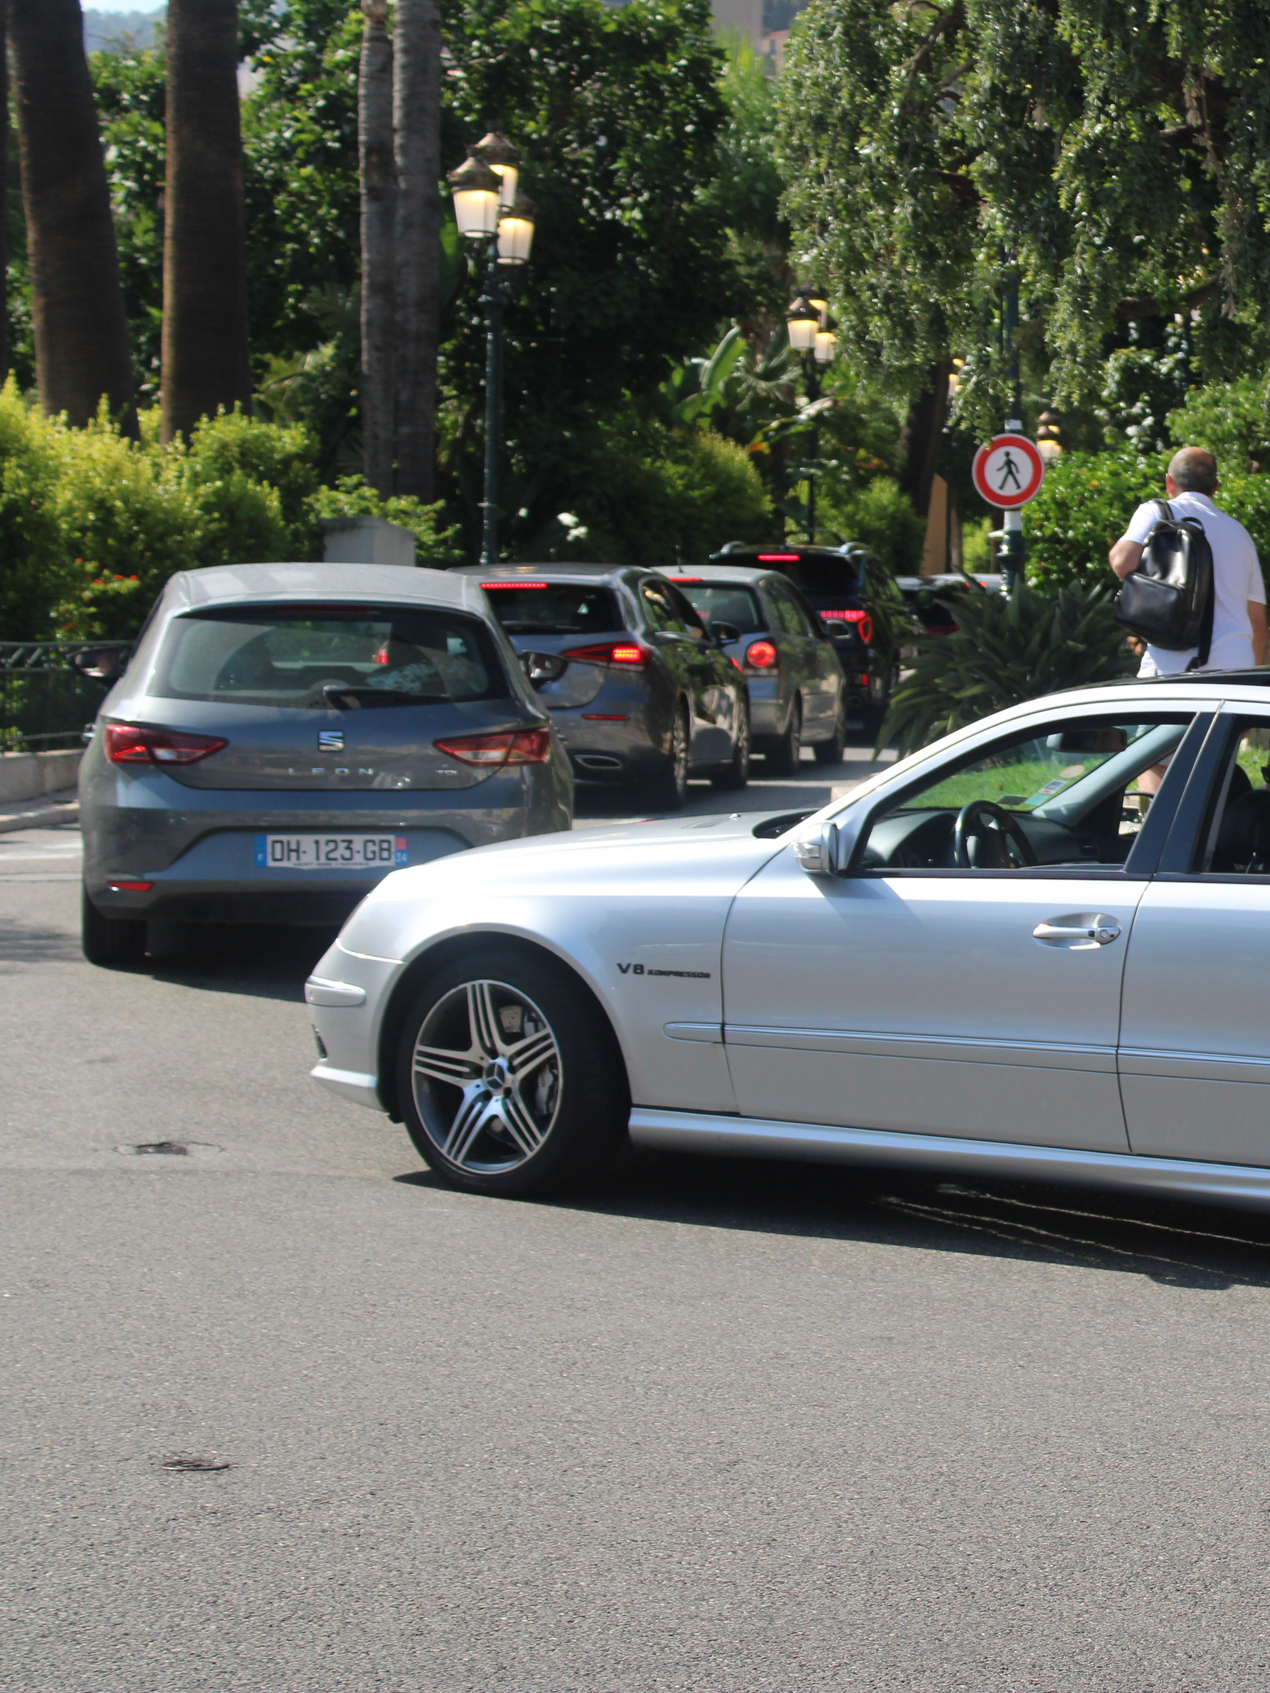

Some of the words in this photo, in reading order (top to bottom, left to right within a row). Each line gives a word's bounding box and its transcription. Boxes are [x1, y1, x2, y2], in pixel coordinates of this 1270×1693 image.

[288, 767, 374, 776] LEON
[270, 839, 393, 862] DH-123-GB
[395, 852, 407, 862] 34
[617, 963, 644, 975] V8
[647, 969, 711, 978] KOMPRESSOR
